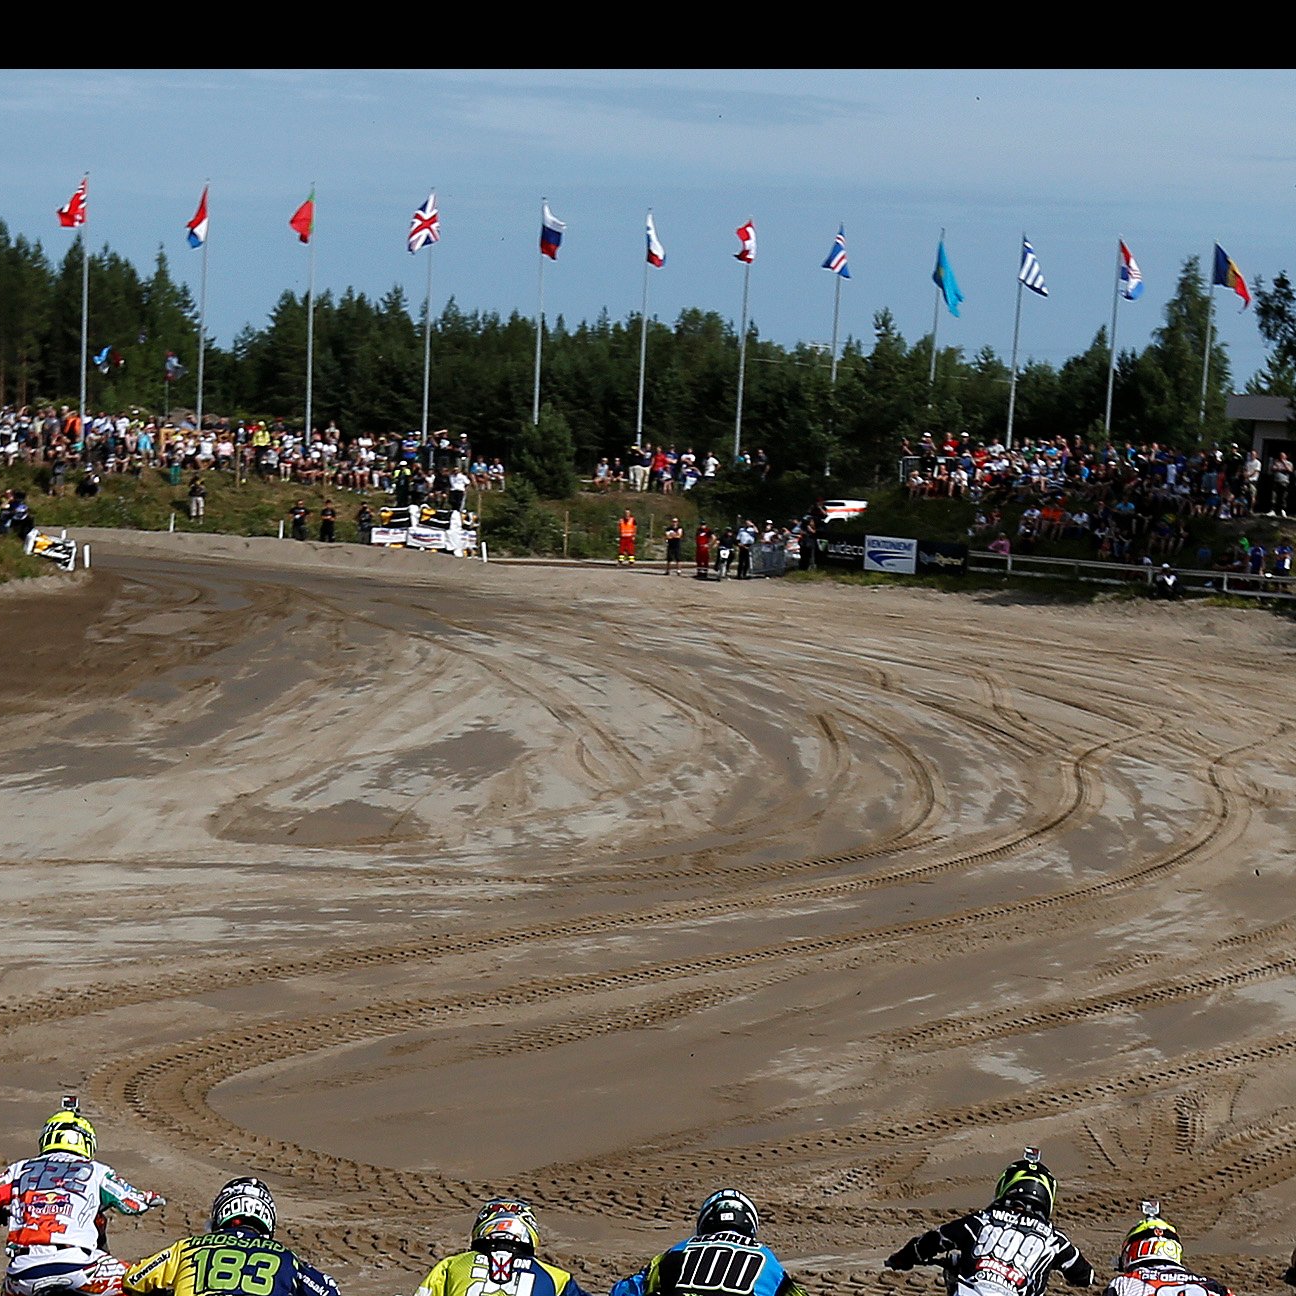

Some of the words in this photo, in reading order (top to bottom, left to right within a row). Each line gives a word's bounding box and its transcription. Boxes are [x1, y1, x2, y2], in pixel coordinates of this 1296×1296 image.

[128, 1251, 171, 1286] Kawasaki
[675, 1246, 767, 1295] 100
[973, 1224, 1045, 1272] 999
[193, 1249, 281, 1296] 183
